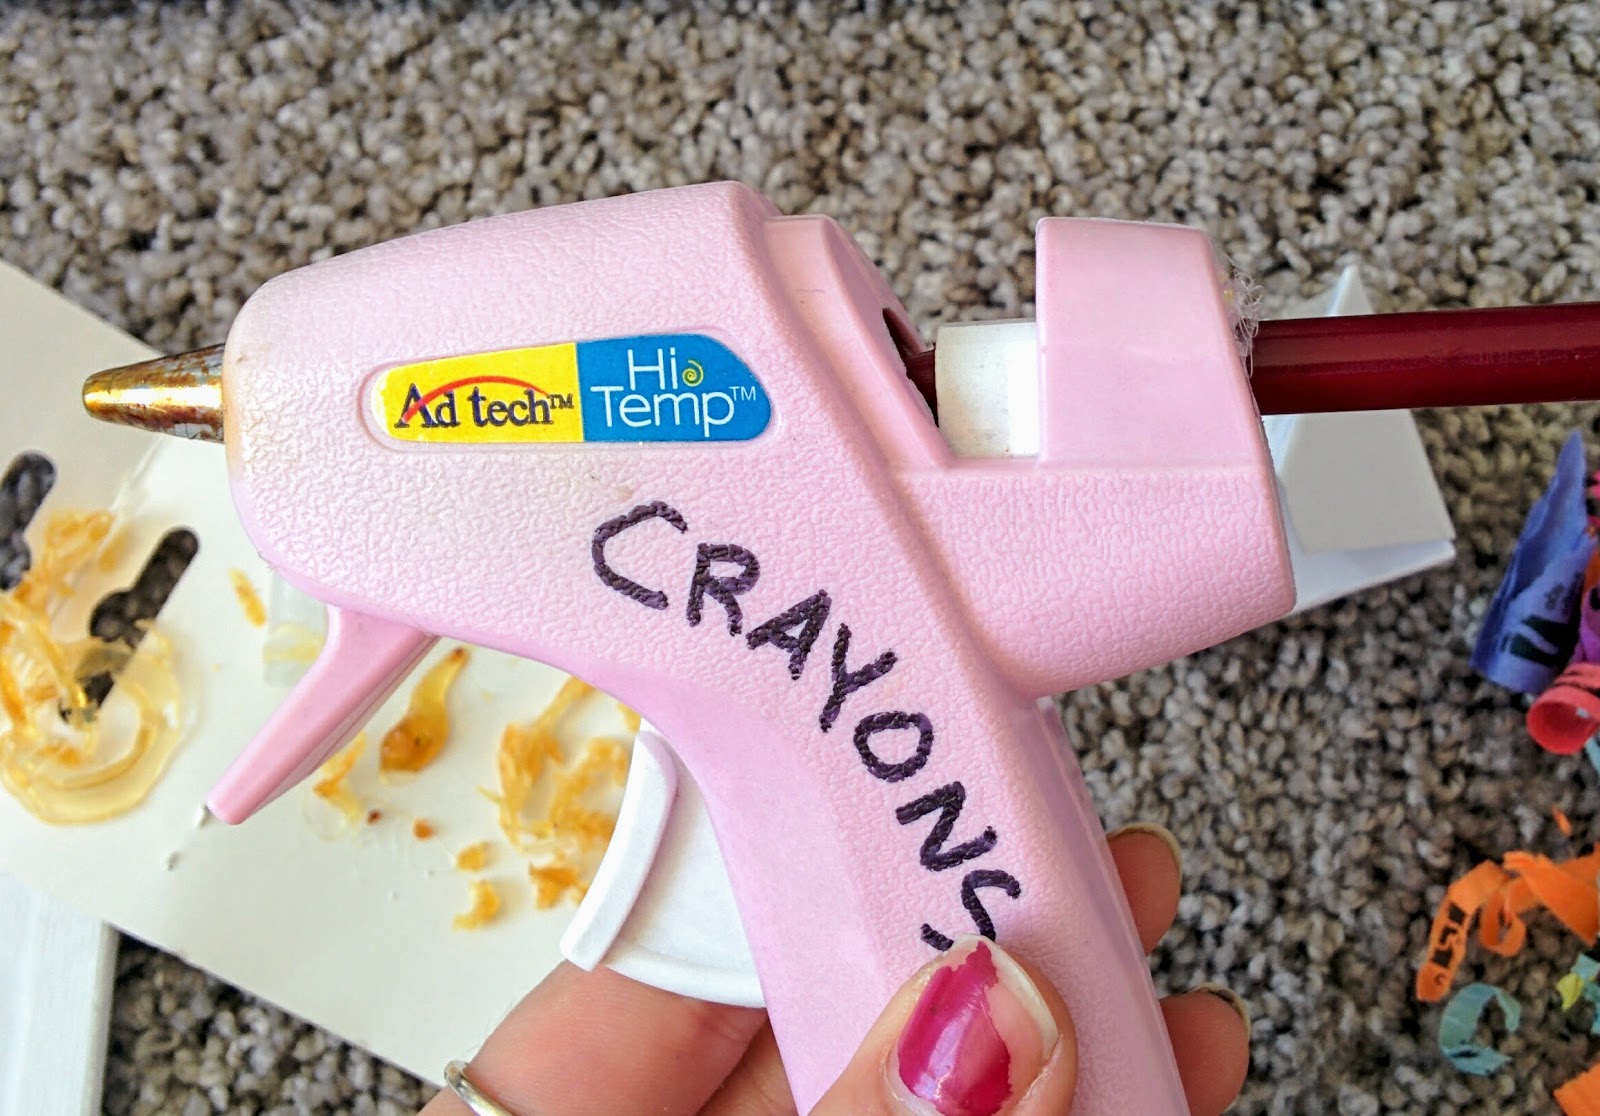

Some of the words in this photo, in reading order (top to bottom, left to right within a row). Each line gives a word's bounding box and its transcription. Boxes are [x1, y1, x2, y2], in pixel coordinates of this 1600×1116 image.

[627, 346, 678, 391] Hi
[394, 382, 460, 429] Ad
[591, 500, 1022, 951] CRAYONS
